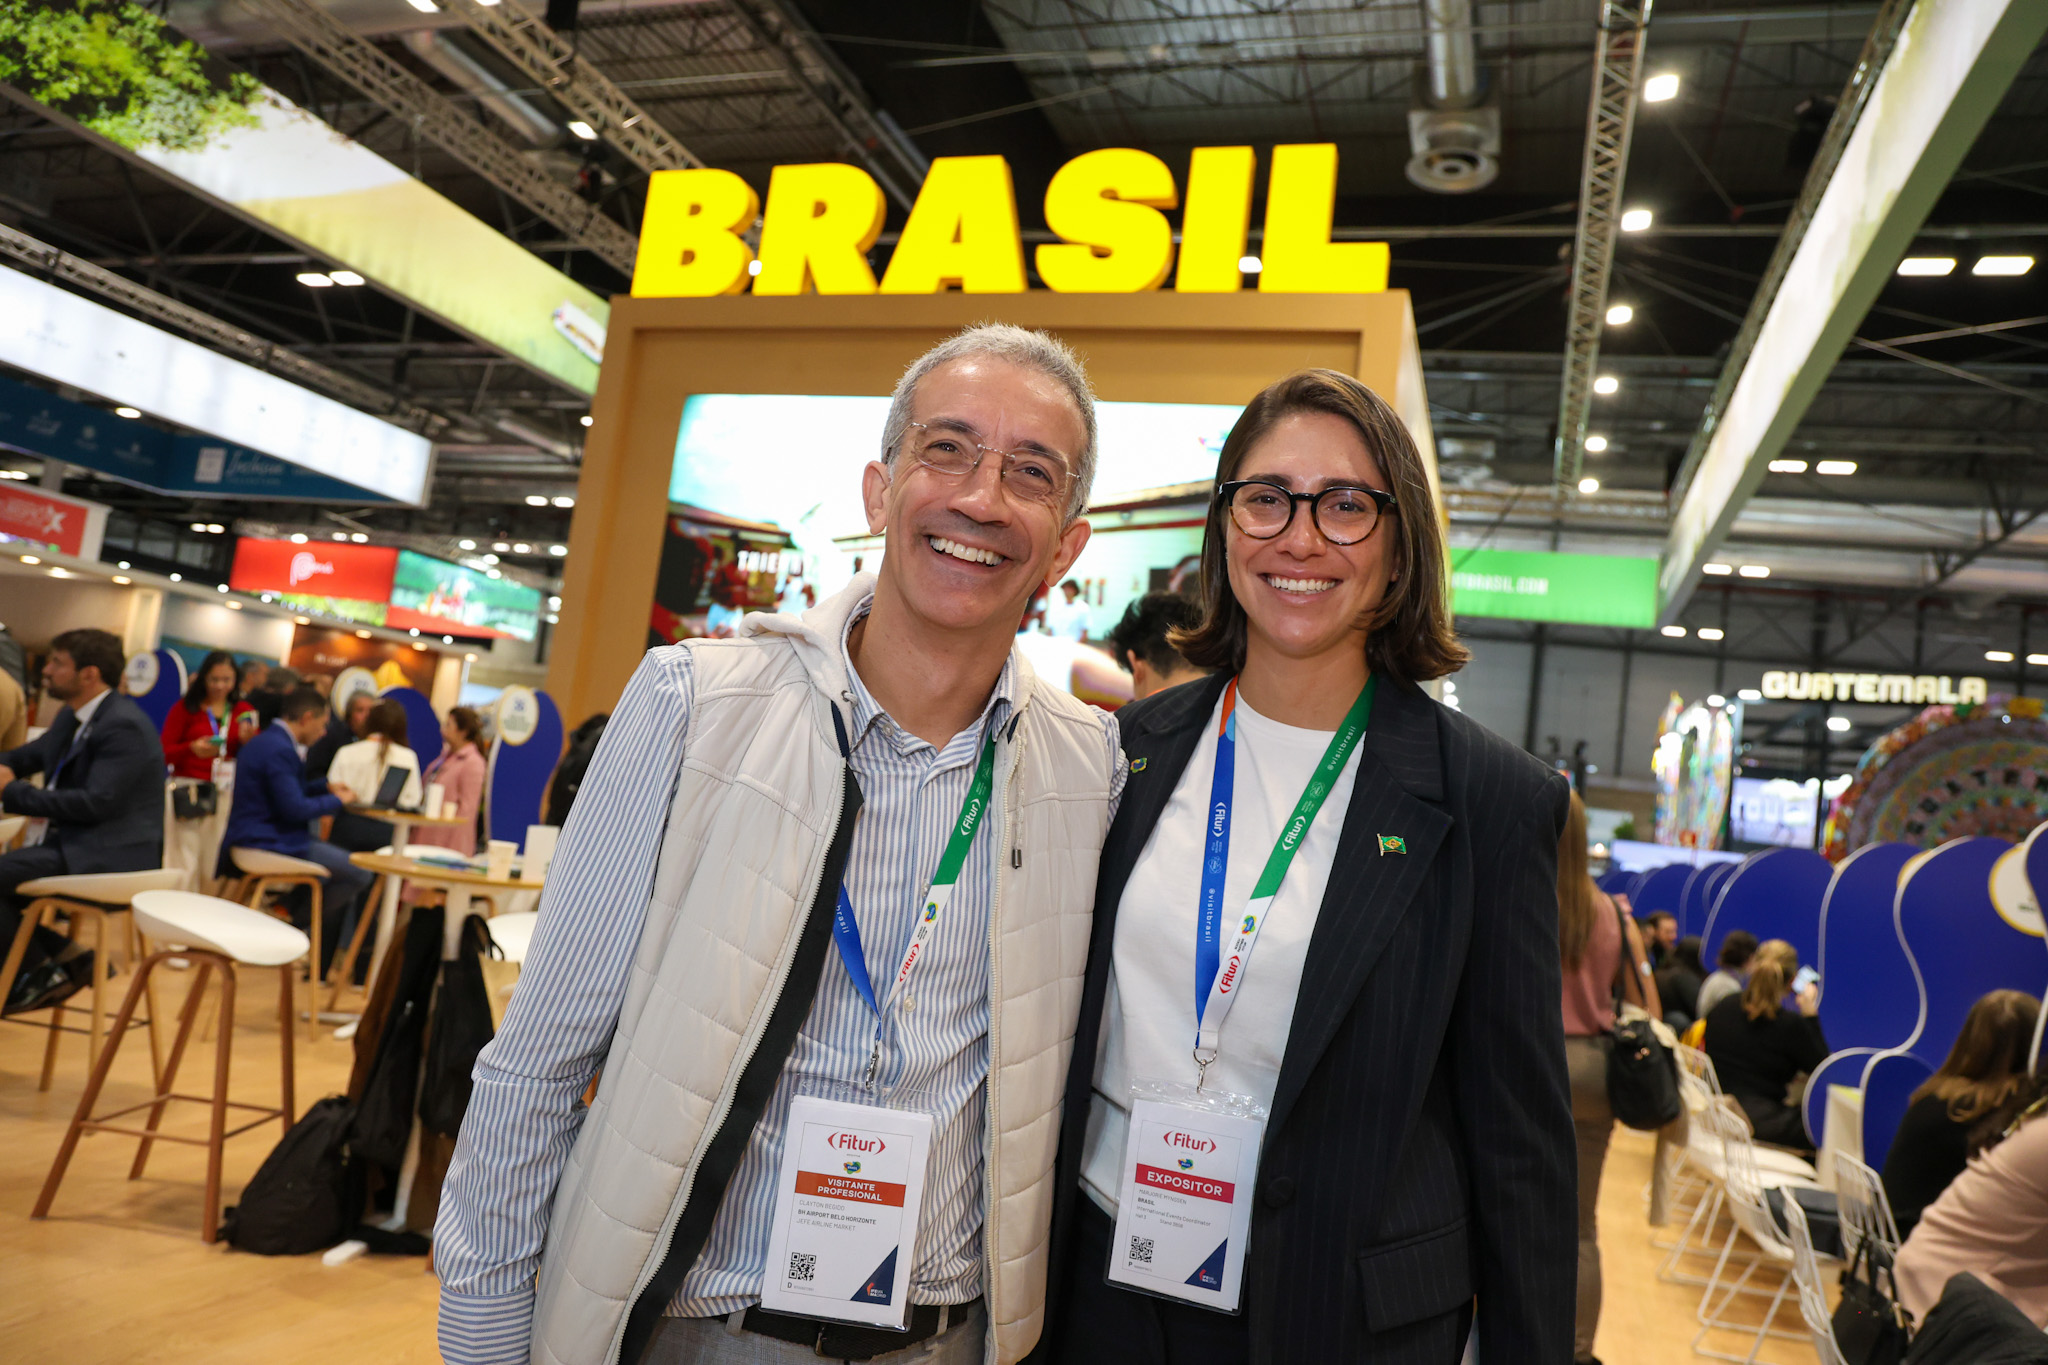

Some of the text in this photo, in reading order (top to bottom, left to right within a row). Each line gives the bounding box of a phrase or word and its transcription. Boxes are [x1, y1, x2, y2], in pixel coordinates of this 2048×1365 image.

[631, 143, 1390, 298] BRASIL
[1761, 671, 1987, 705] GUATEMALA
[1327, 726, 1356, 770] @visitbrasil
[963, 804, 979, 830] Fitur
[1214, 809, 1225, 831] Fitur
[1284, 820, 1303, 845] Fitur
[1204, 888, 1216, 942] @visitbrasil
[902, 949, 917, 976] Fitur
[1221, 961, 1238, 988] Fitur
[839, 1133, 876, 1153] Fitur
[1173, 1132, 1207, 1152] Fitur
[817, 1186, 883, 1201] PROFESIONAL
[828, 1178, 875, 1191] VISITANTE
[1147, 1171, 1223, 1196] EXPOSITOR
[1137, 1197, 1155, 1206] BRASIL
[806, 1210, 830, 1219] AIRPORT
[830, 1213, 845, 1221] BELO
[845, 1216, 877, 1225] HORIZONTE
[811, 1220, 832, 1229] AIRLINE
[833, 1223, 856, 1231] MARKET
